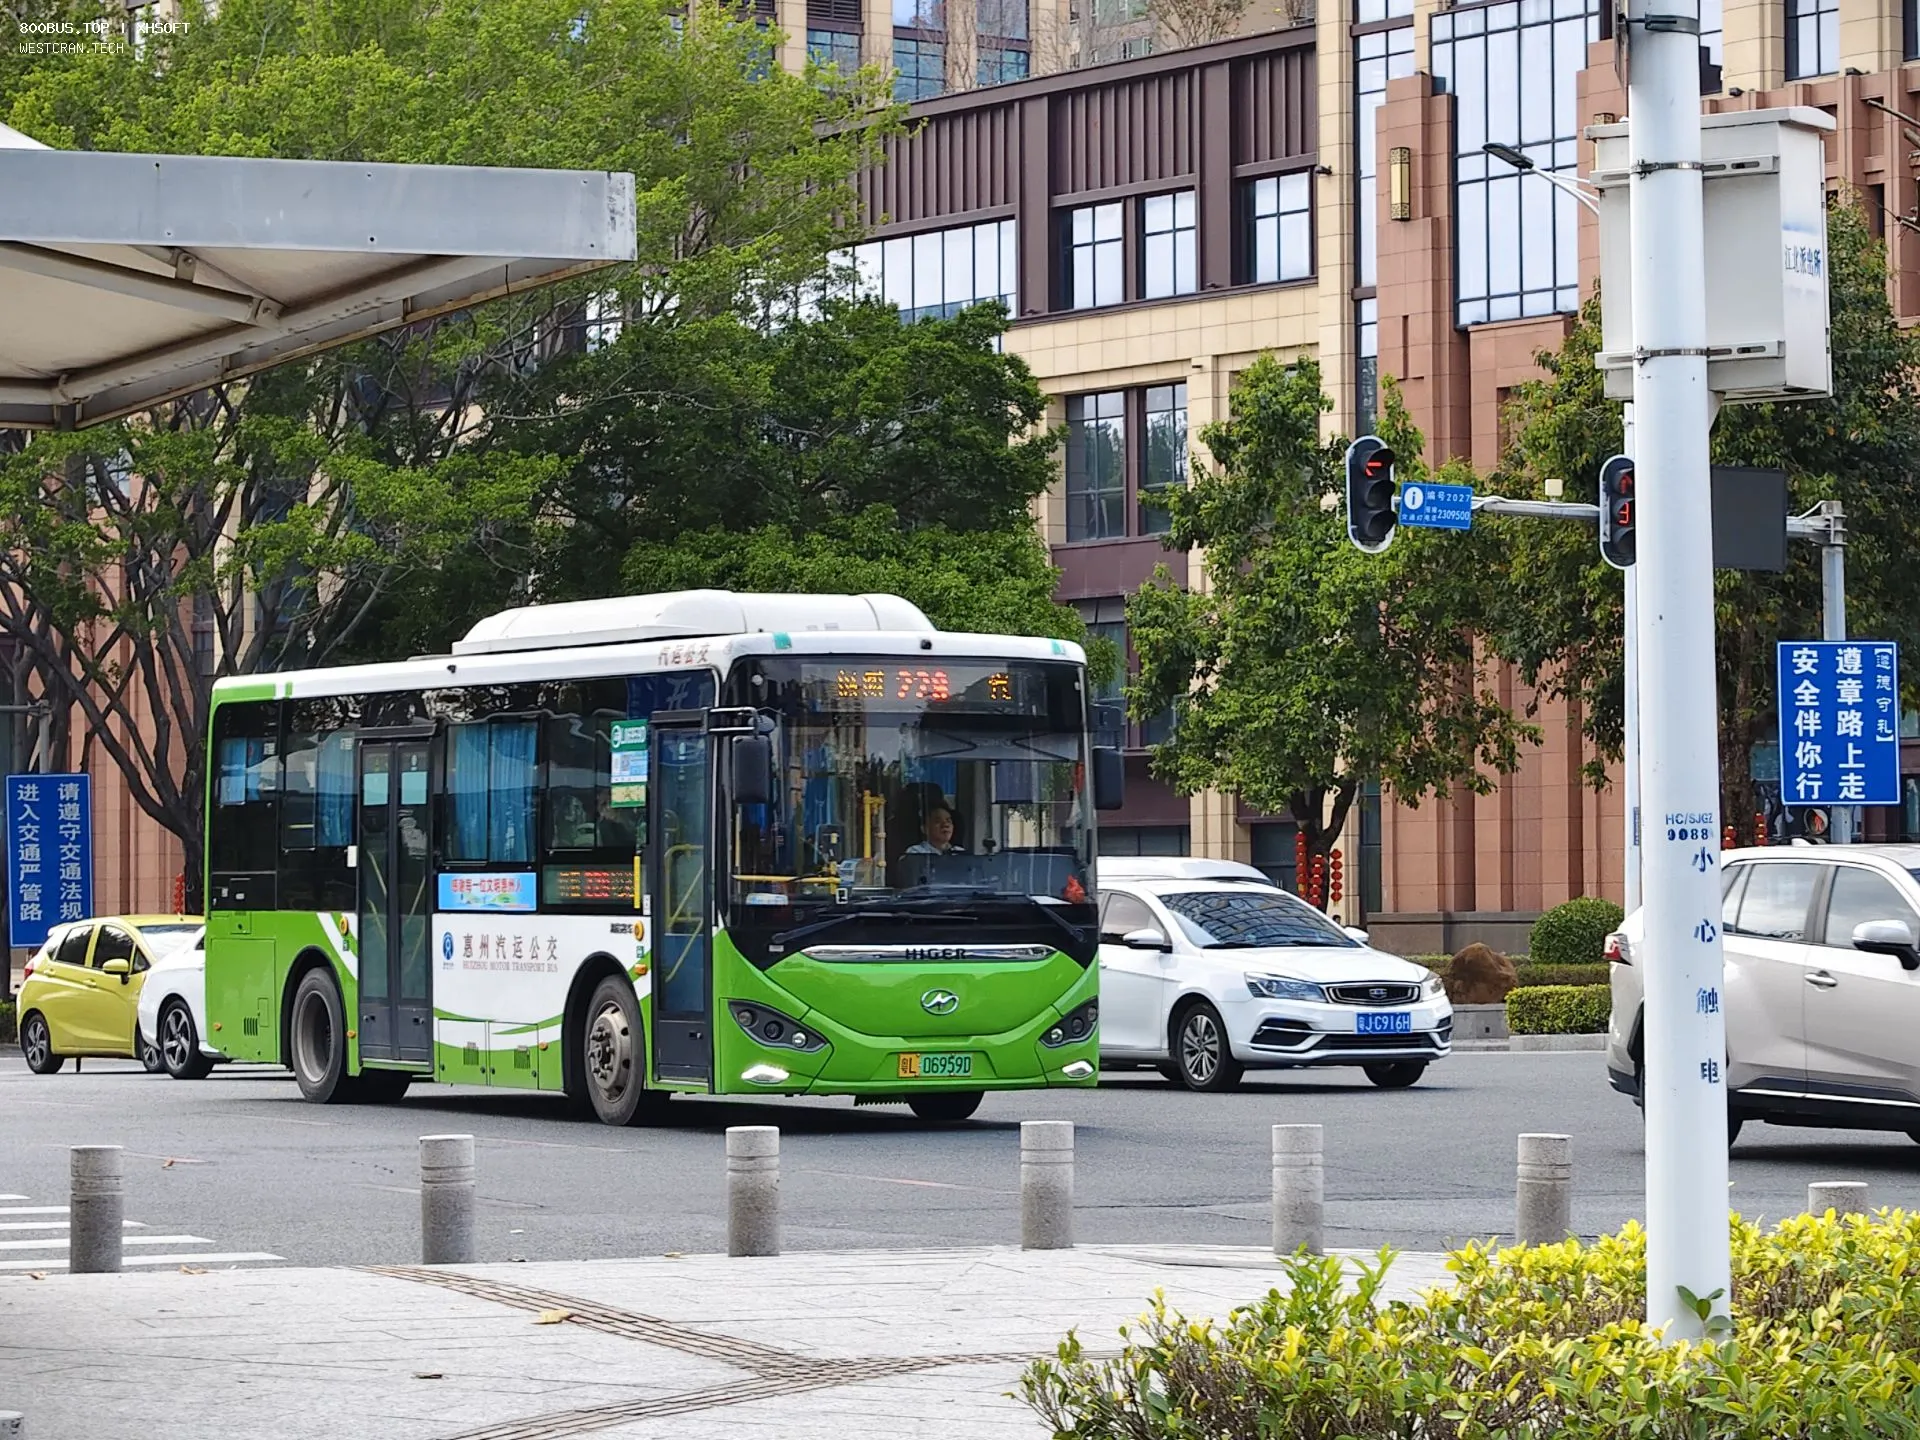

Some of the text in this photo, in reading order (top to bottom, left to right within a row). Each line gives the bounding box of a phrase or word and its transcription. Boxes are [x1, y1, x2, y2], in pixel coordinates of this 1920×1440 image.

[1784, 244, 1821, 278] 江北派出所
[1437, 509, 1470, 521] 2309500
[1792, 647, 1823, 800] 安全伴你行
[1835, 647, 1866, 800] 遵章路上走
[17, 784, 42, 921] 进入交通严管路
[58, 783, 83, 920] 请遵守交通法规
[463, 932, 558, 961] 惠州汽运公交
[905, 948, 967, 960] HIGER
[1692, 846, 1720, 1083] 小心触电
